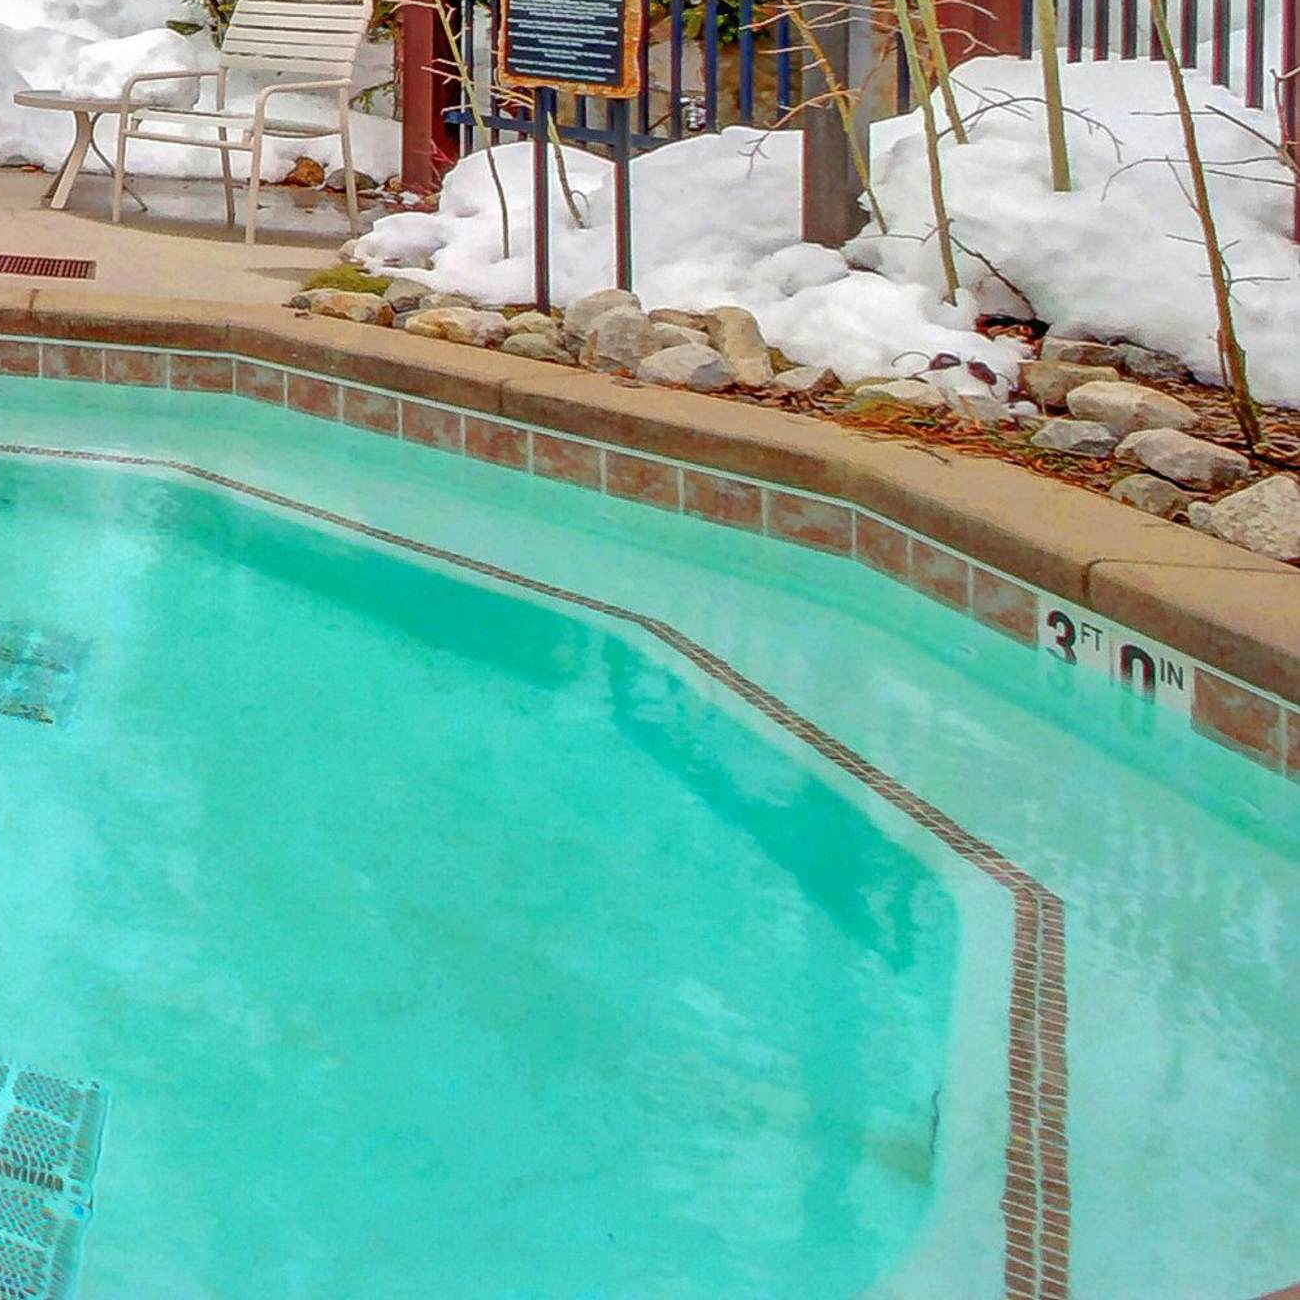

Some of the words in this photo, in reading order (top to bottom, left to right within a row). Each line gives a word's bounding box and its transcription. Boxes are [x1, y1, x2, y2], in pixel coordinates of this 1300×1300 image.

[1047, 610, 1077, 666] 3
[1081, 622, 1103, 651] FT
[1160, 657, 1184, 690] IN
